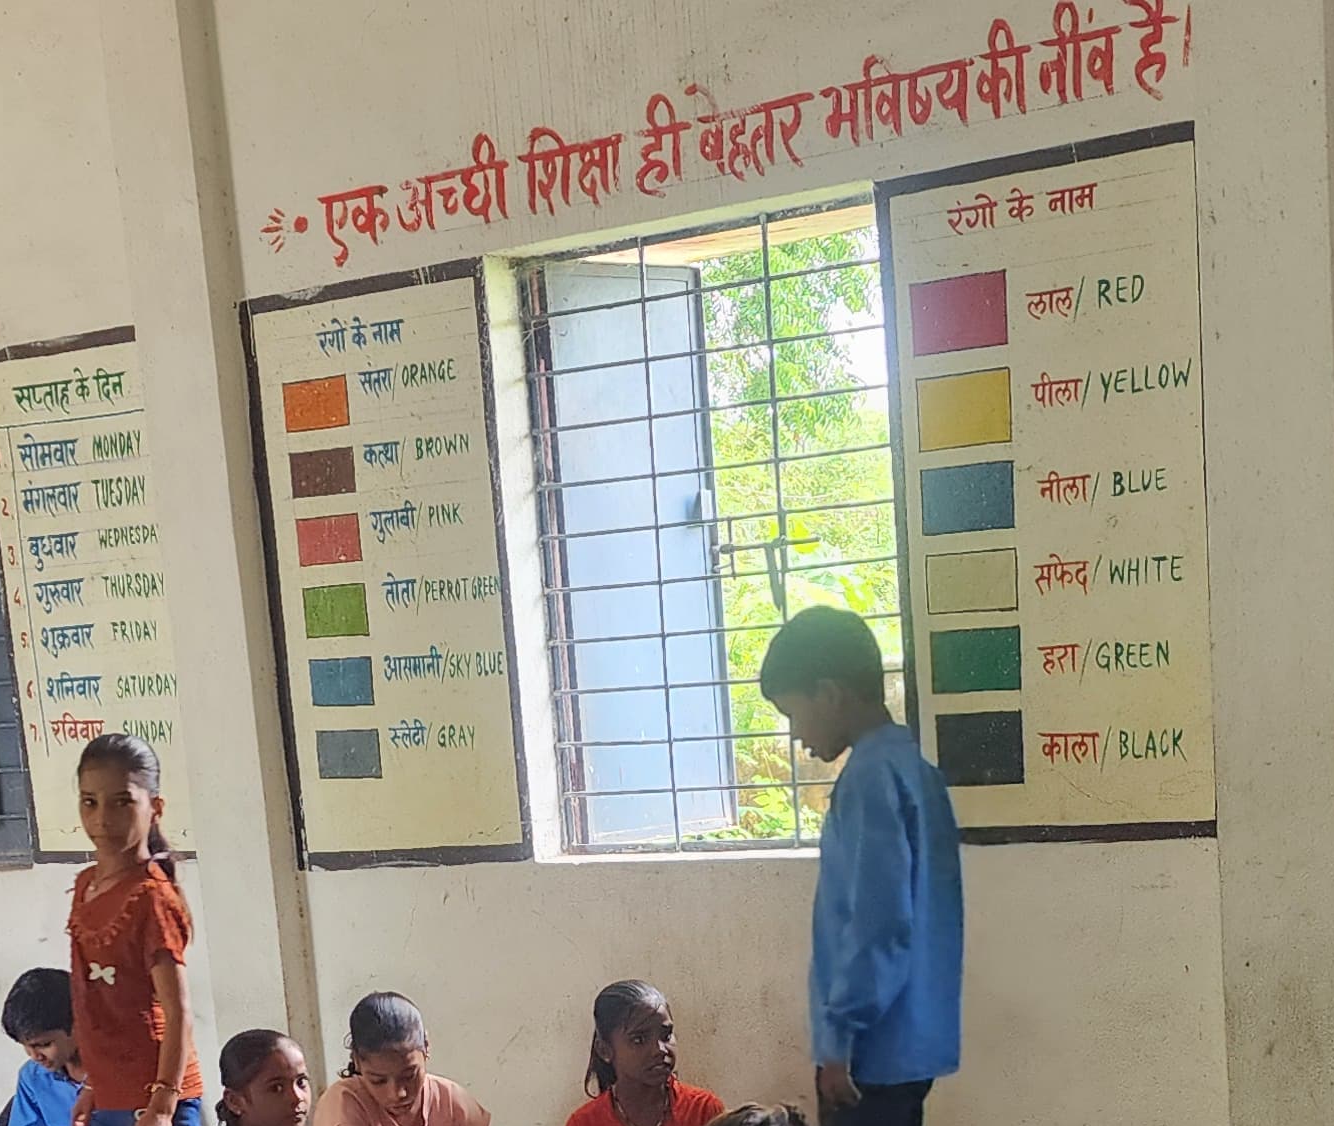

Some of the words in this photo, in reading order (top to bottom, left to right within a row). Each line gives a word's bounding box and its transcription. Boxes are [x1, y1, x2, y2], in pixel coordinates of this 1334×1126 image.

[318, 185, 388, 267] एक
[518, 126, 626, 217] शिक्षा
[635, 98, 692, 198] ही
[819, 54, 974, 147] भविष्य
[976, 18, 1033, 119] की
[1039, 0, 1123, 104] नींव
[1125, 0, 1181, 101] है
[1006, 188, 1034, 222] के
[1045, 182, 1098, 215] नाम
[1097, 273, 1145, 310] RED
[350, 316, 367, 350] के
[371, 318, 404, 345] नाम
[74, 367, 91, 403] के
[92, 367, 126, 406] दिन
[401, 358, 458, 388] ORANGE
[1100, 357, 1192, 404] YELLOW
[17, 433, 79, 471] सोमवार
[92, 430, 141, 460] MONDAY
[415, 433, 470, 461] BROWN
[20, 480, 82, 518] मंगलवार
[91, 475, 146, 511] TUESDAY
[1111, 467, 1168, 498] BLUE
[428, 503, 463, 529] PINK
[27, 532, 79, 572] बुधवार
[98, 524, 160, 550] WEDNESDA
[101, 572, 165, 599] THURSDAY
[1108, 555, 1185, 586] WHITE
[41, 623, 95, 659] शुक्रवार
[110, 620, 158, 643] FRIDAY
[1095, 639, 1171, 673] GREEN
[475, 651, 504, 677] BLUE
[46, 671, 103, 706] शनिवार
[116, 673, 178, 699] SATURDAY
[49, 712, 106, 746] रविवार
[437, 724, 476, 750] GRAY
[1118, 728, 1188, 762] BLACK
